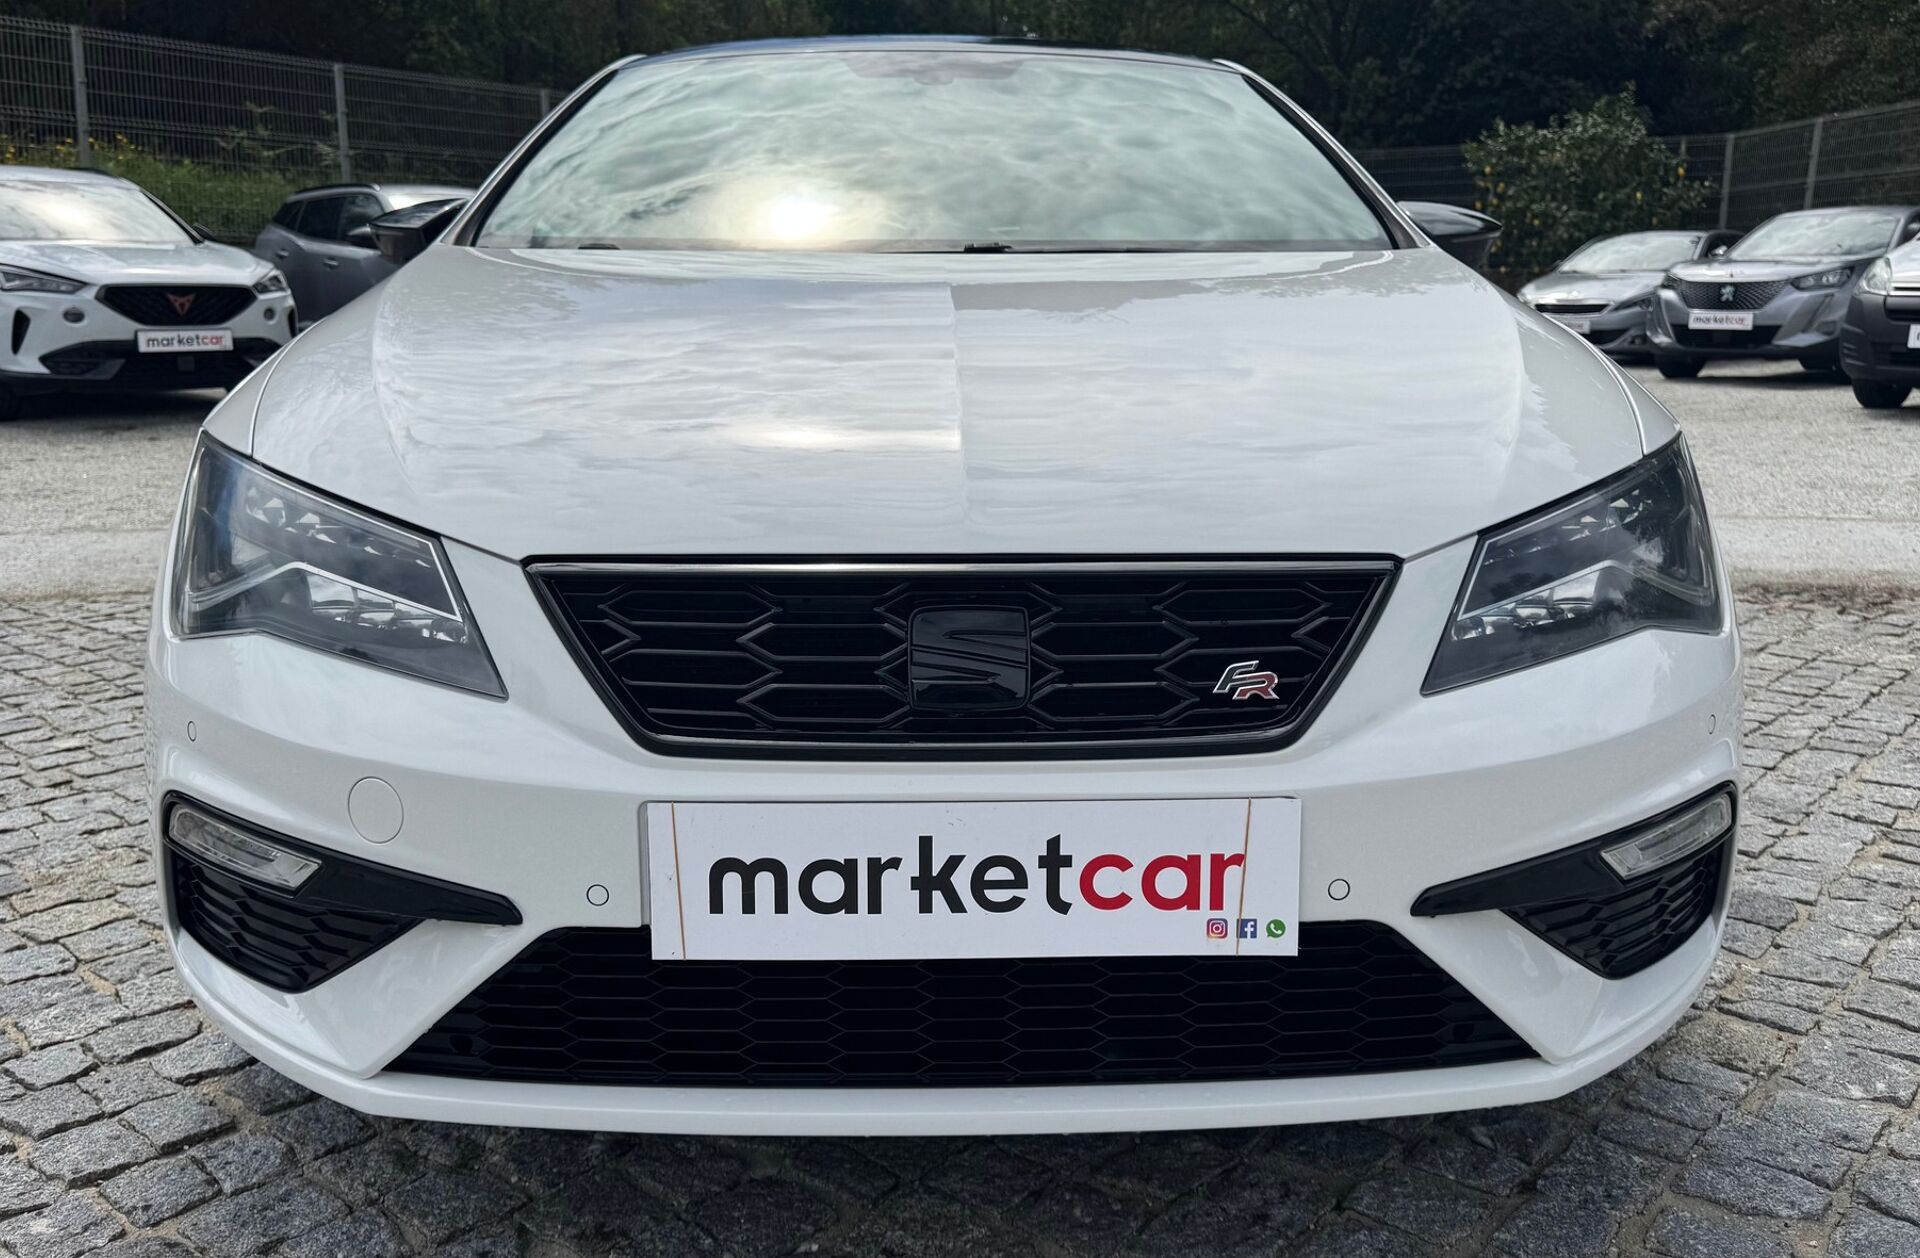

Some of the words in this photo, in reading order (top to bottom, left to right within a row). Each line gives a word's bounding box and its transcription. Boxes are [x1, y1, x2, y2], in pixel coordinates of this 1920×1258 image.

[146, 333, 224, 348] marketcar
[1212, 660, 1280, 700] FR
[708, 833, 1245, 916] marketcar
